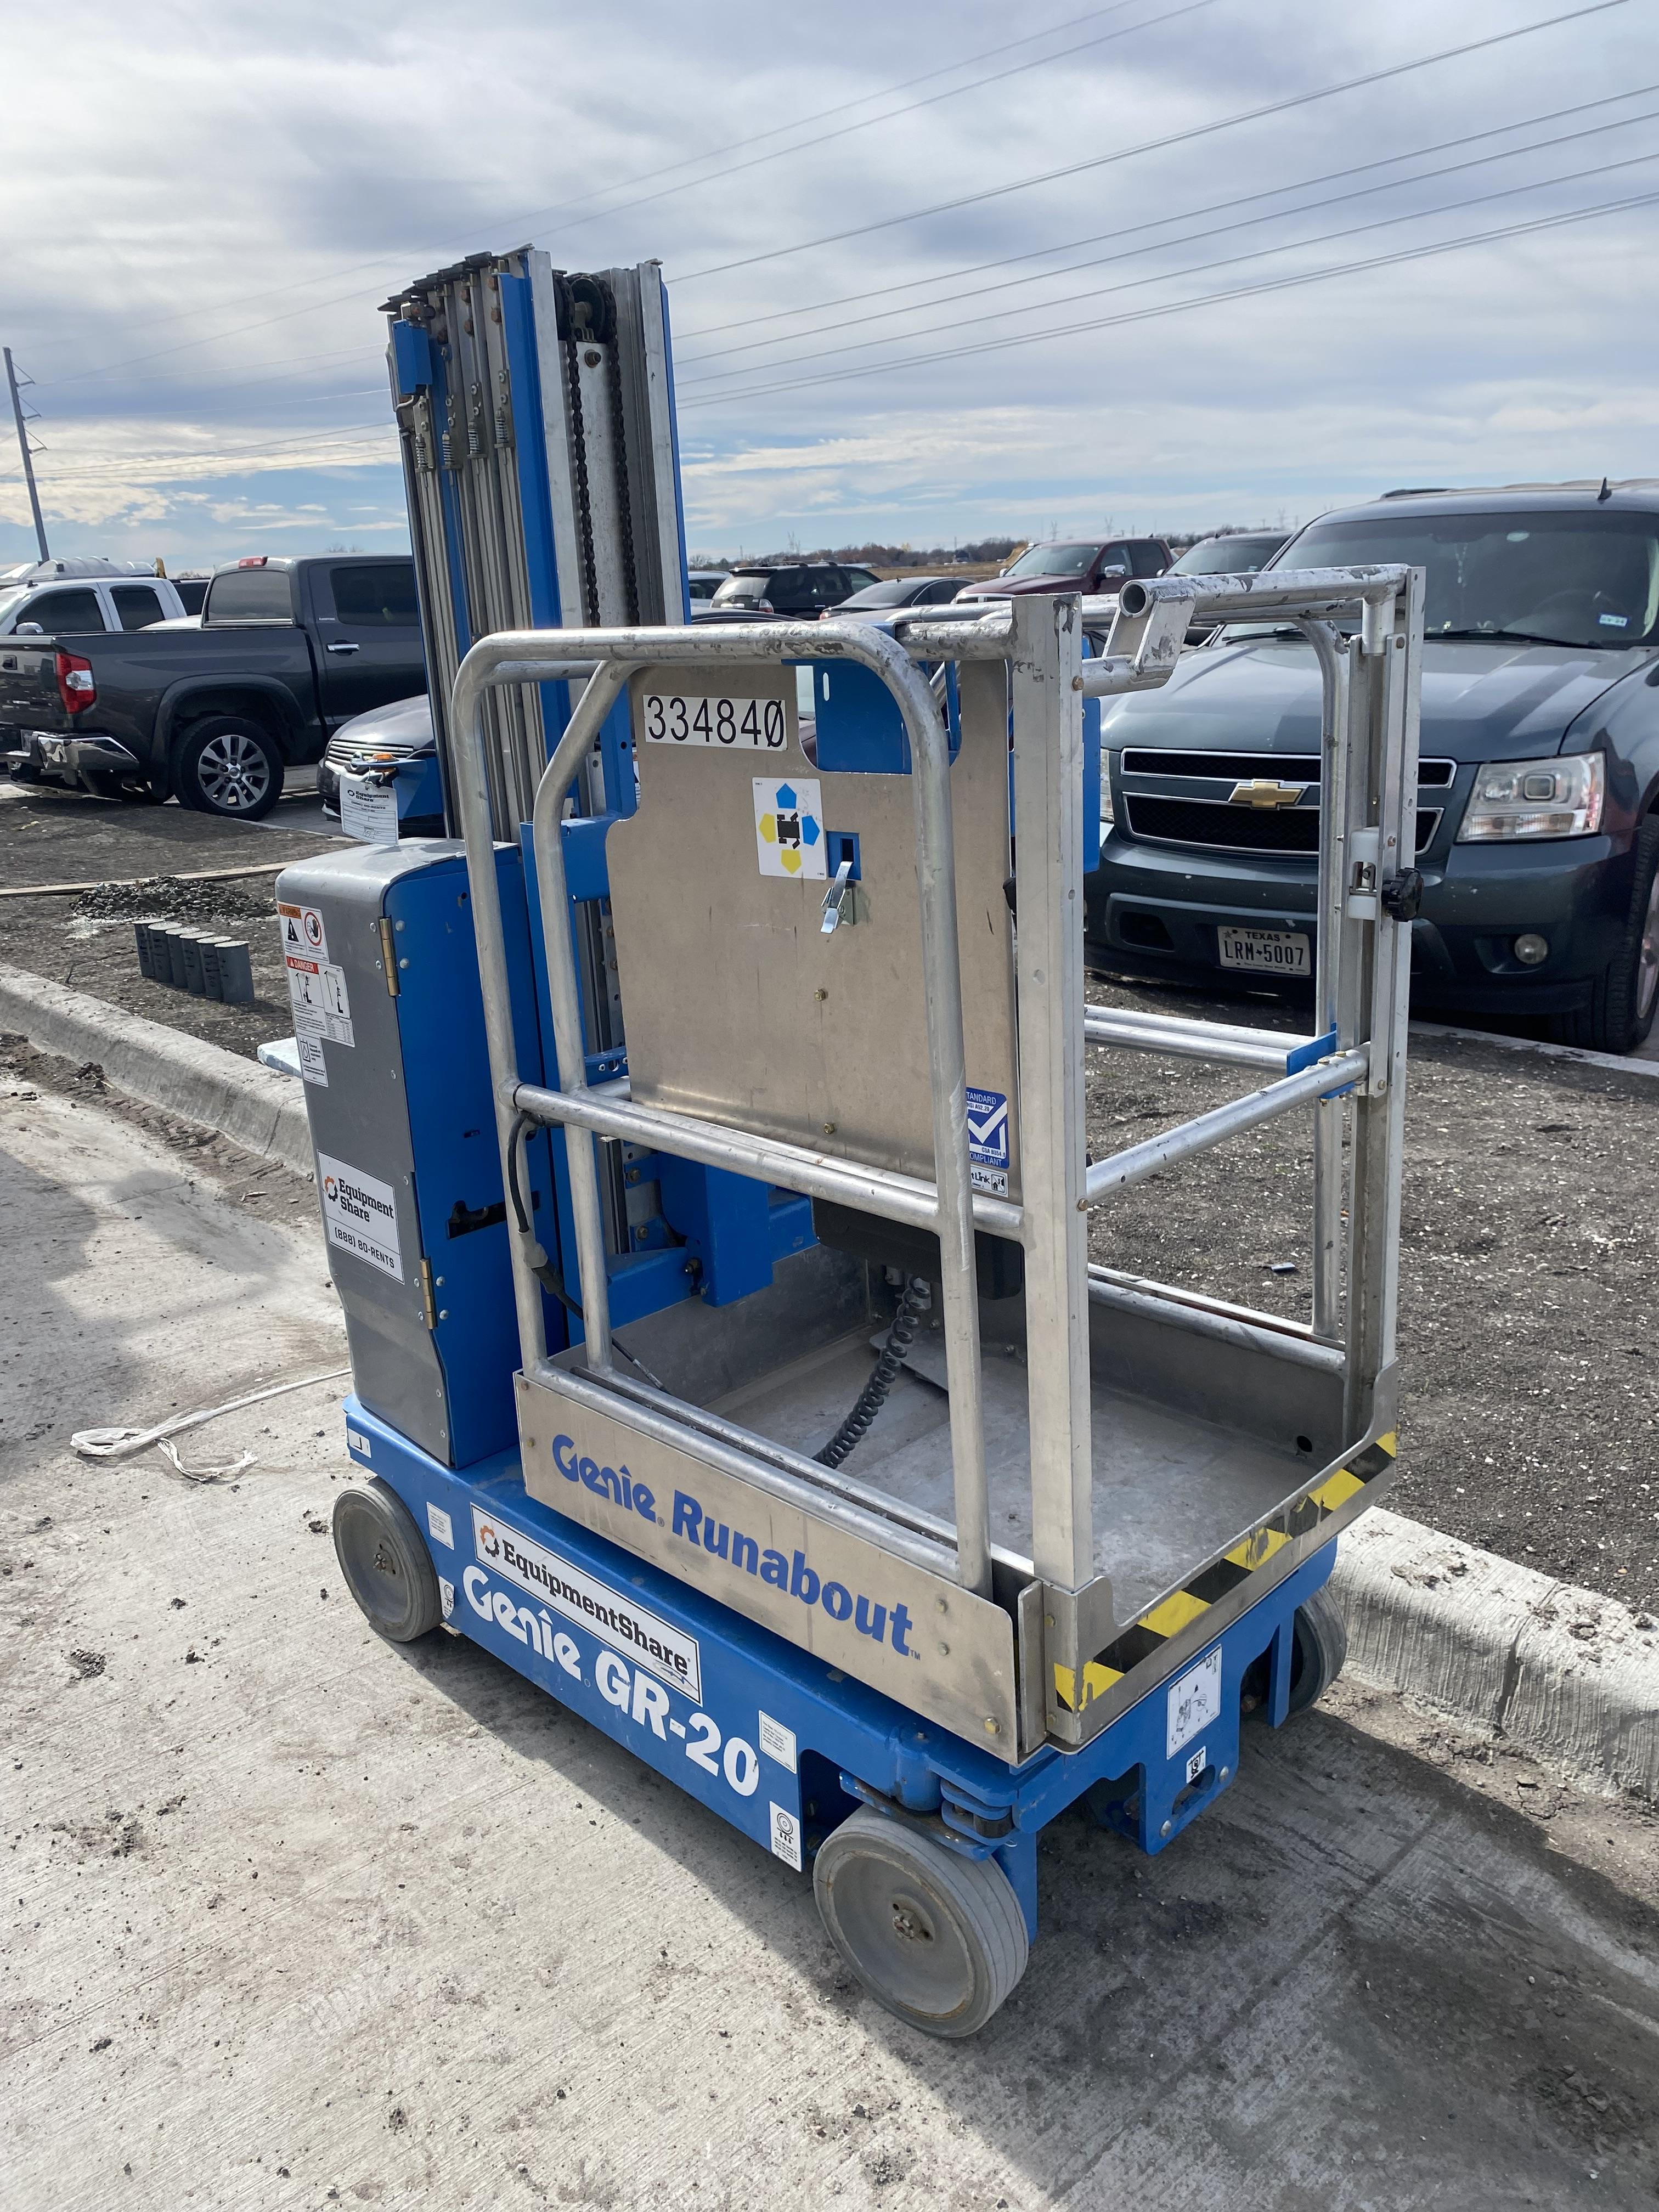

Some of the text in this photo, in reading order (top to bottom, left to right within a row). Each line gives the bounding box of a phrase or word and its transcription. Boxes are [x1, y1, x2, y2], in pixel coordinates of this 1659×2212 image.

[647, 695, 785, 748] 334840
[356, 791, 390, 799] Equipment
[1245, 931, 1280, 941] TEXAS
[294, 959, 314, 972] DANGER
[966, 1091, 996, 1105] TANDARD
[969, 1153, 1002, 1167] OMPLIANT
[970, 1172, 991, 1184] tLink
[338, 1178, 394, 1219] Equipment
[340, 1195, 370, 1222] Share
[334, 1227, 394, 1268] (888) 80-RENTS
[552, 1434, 657, 1523] Genie
[672, 1489, 913, 1657] Runabout
[502, 1538, 688, 1676] EquipmentShare
[462, 1565, 759, 1797] Genie GR-20
